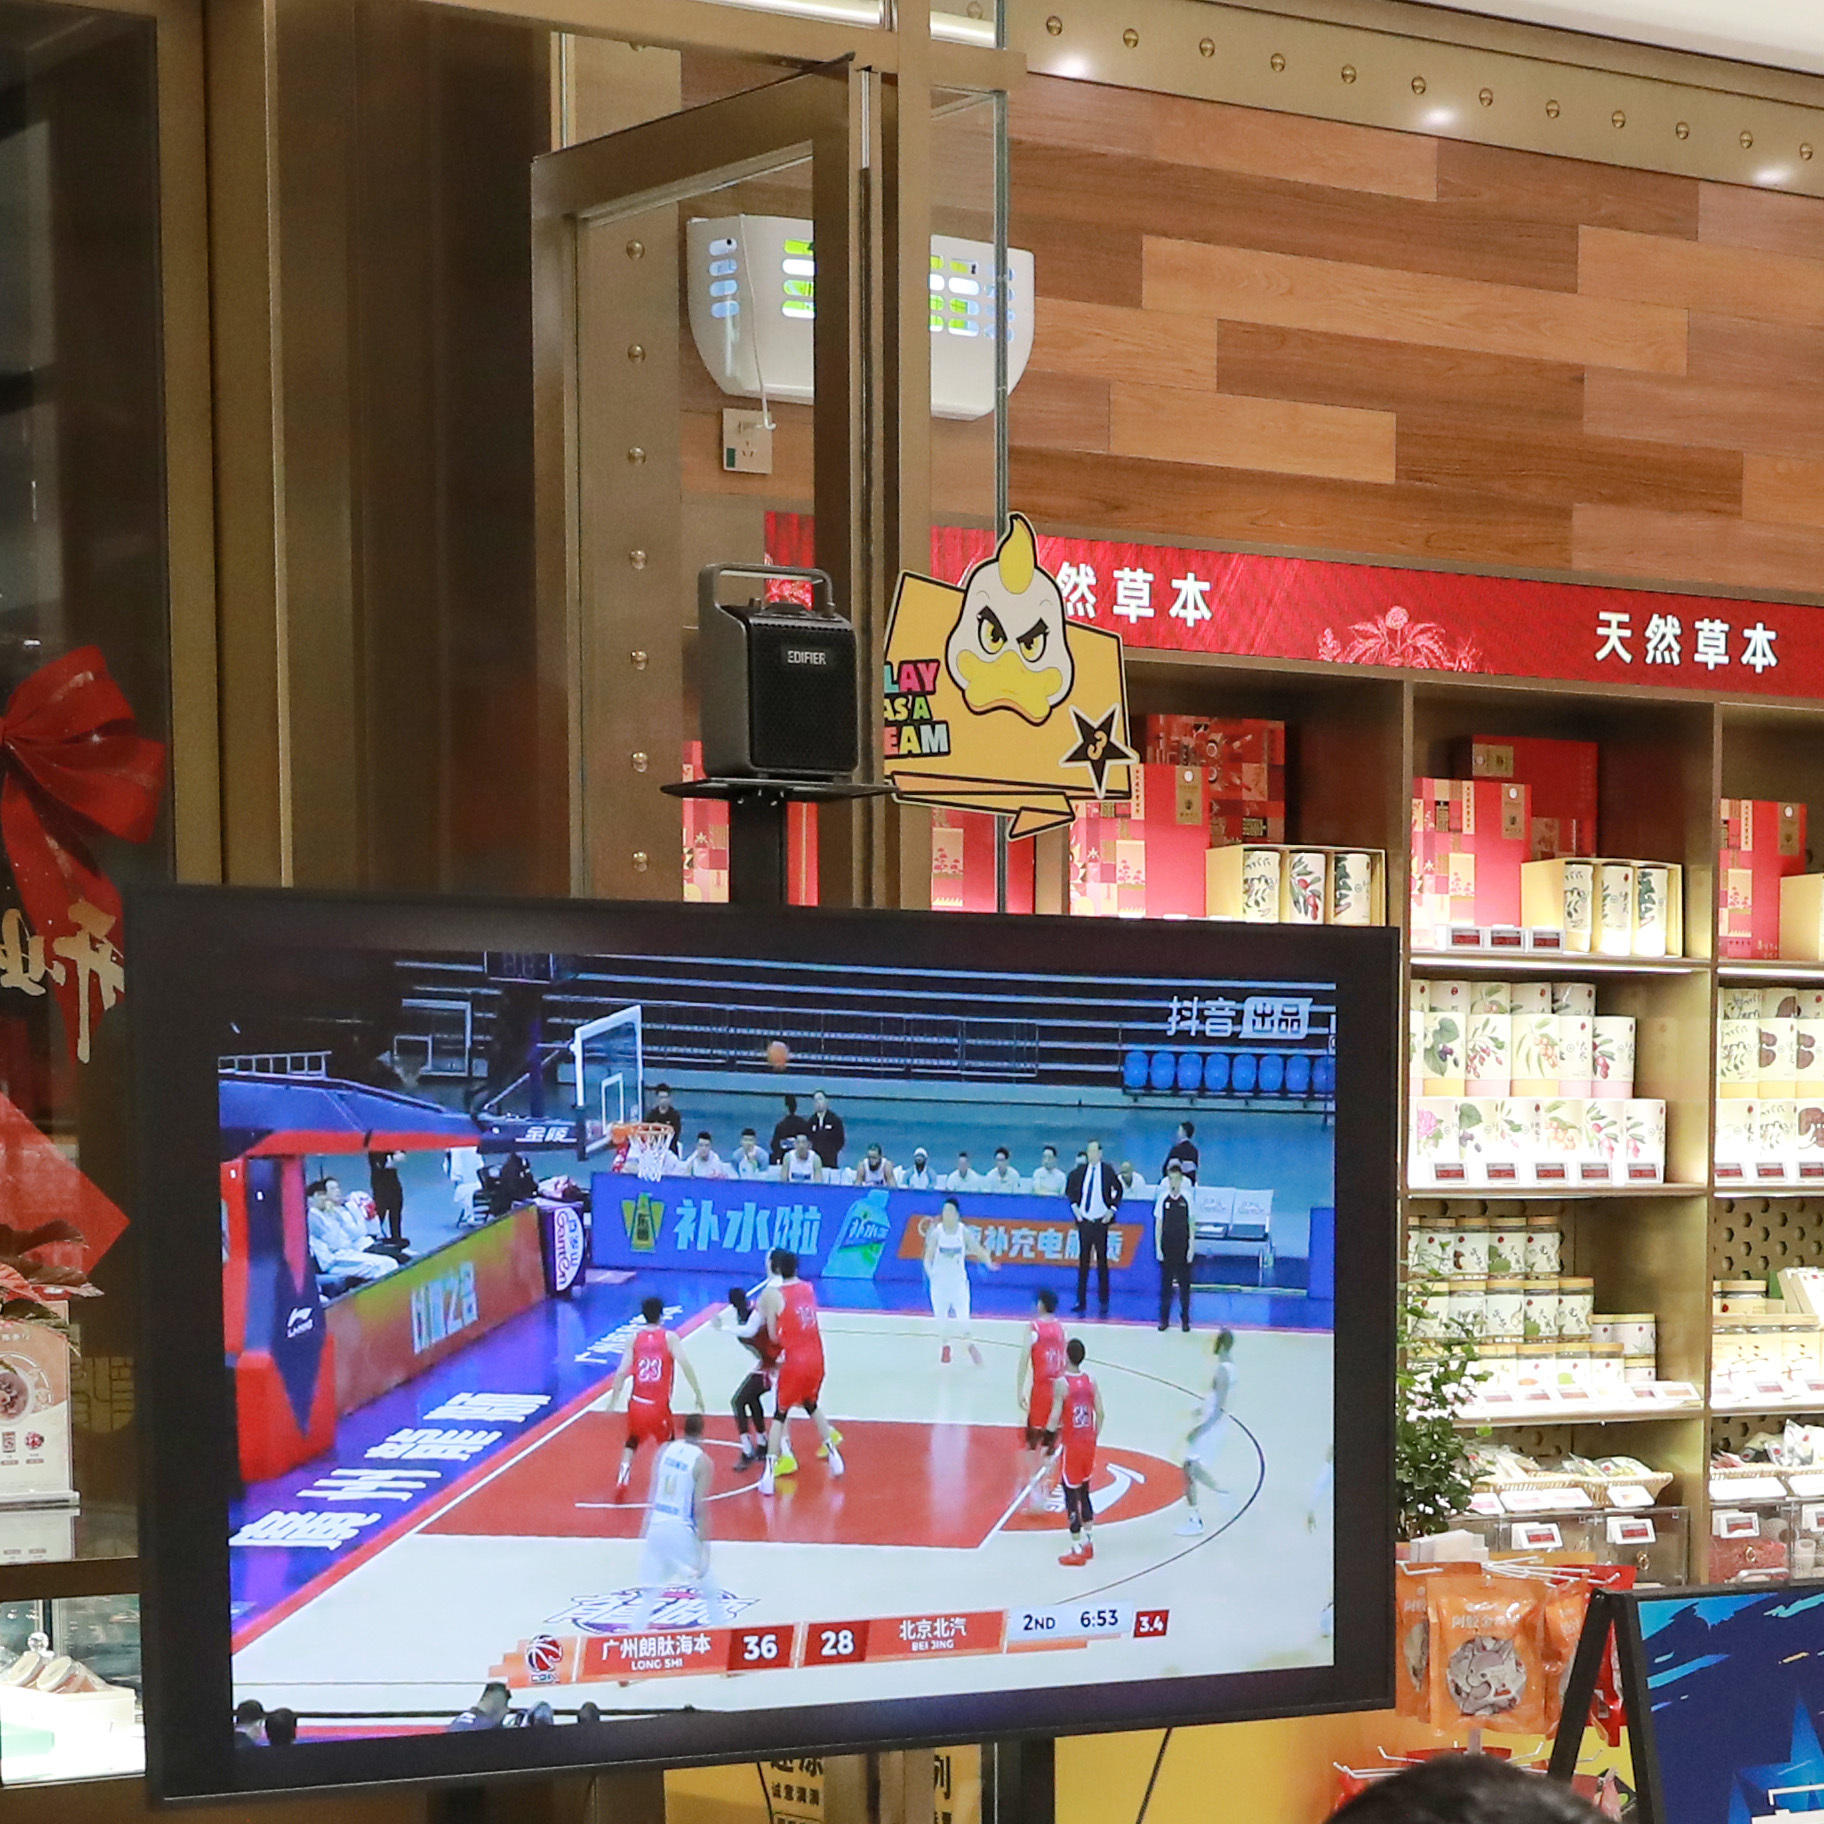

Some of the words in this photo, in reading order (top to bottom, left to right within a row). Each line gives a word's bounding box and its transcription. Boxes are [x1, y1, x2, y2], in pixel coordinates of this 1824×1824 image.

[1594, 609, 1781, 675] 天然草本
[786, 649, 827, 668] EDIFIER
[884, 659, 939, 694] LAY
[911, 696, 931, 721] A
[884, 722, 950, 759] EAM
[1086, 730, 1109, 761] 3
[1166, 995, 1313, 1039] 抖音出品
[673, 1198, 822, 1256] 补水啦
[638, 1357, 662, 1382] 23
[1023, 1614, 1057, 1632] 2ND
[1080, 1609, 1119, 1628] 6:53
[1139, 1614, 1165, 1633] 3.4
[601, 1633, 712, 1661] 广州朗肽海本
[743, 1634, 778, 1660] 36
[819, 1629, 855, 1656] 28
[899, 1616, 968, 1641] 北京北汽
[911, 1640, 930, 1652] BEI
[931, 1638, 955, 1651] JING
[631, 1657, 662, 1671] LONG
[664, 1656, 684, 1669] SHI
